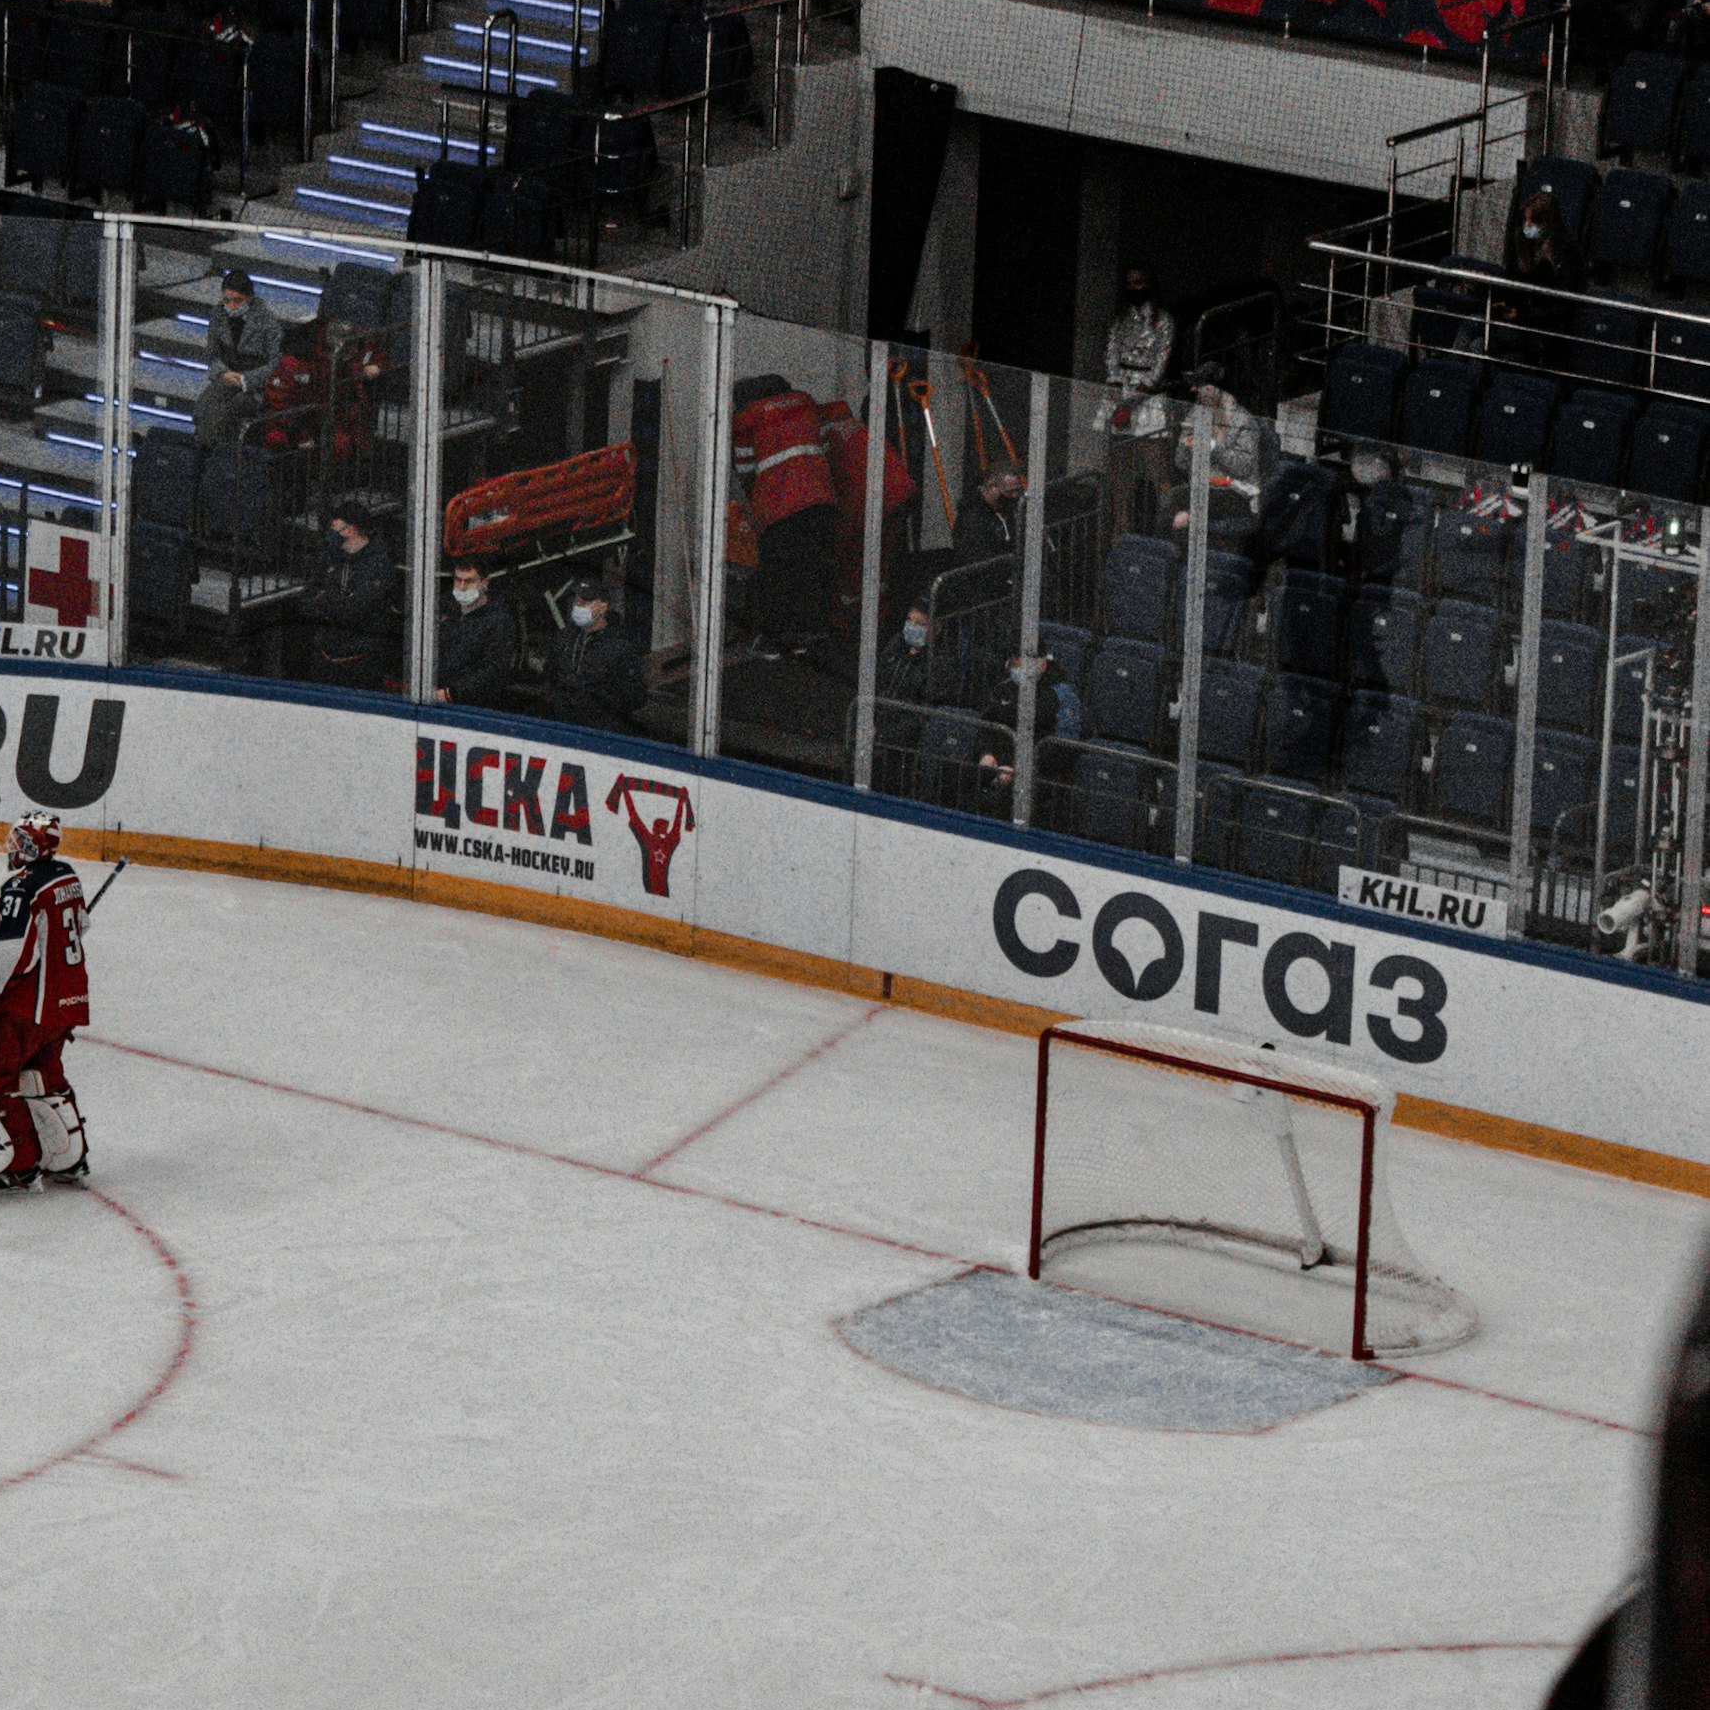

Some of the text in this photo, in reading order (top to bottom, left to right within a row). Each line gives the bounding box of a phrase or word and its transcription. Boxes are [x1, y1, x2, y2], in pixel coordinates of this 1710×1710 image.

[415, 737, 593, 846] ЦСКА
[415, 828, 595, 881] WWW.CSKA-HOCKEY.RU
[1, 894, 23, 918] 31
[1359, 874, 1488, 930] KHL.RU
